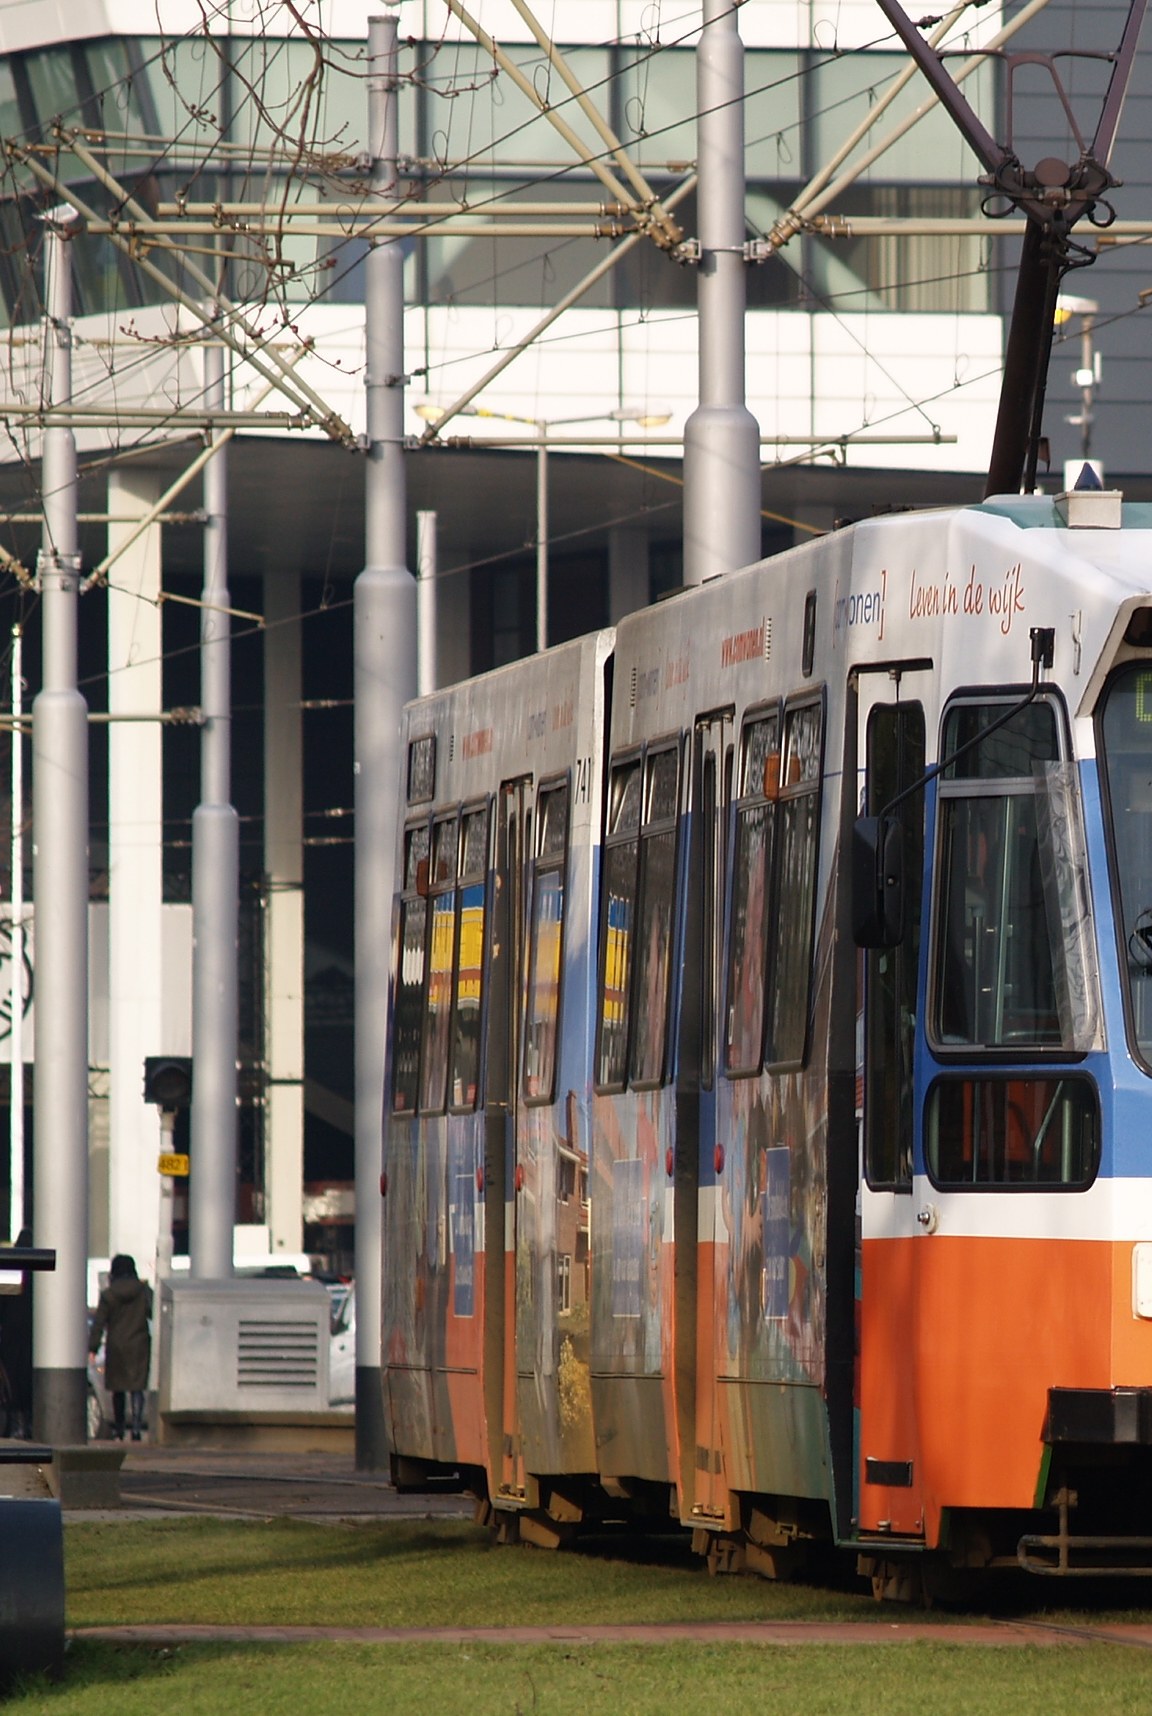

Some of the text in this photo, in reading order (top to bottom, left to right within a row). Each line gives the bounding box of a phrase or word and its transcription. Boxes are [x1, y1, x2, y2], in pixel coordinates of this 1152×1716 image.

[942, 571, 958, 616] in
[963, 564, 983, 616] de
[989, 562, 1025, 635] wijk
[574, 757, 591, 805] 741
